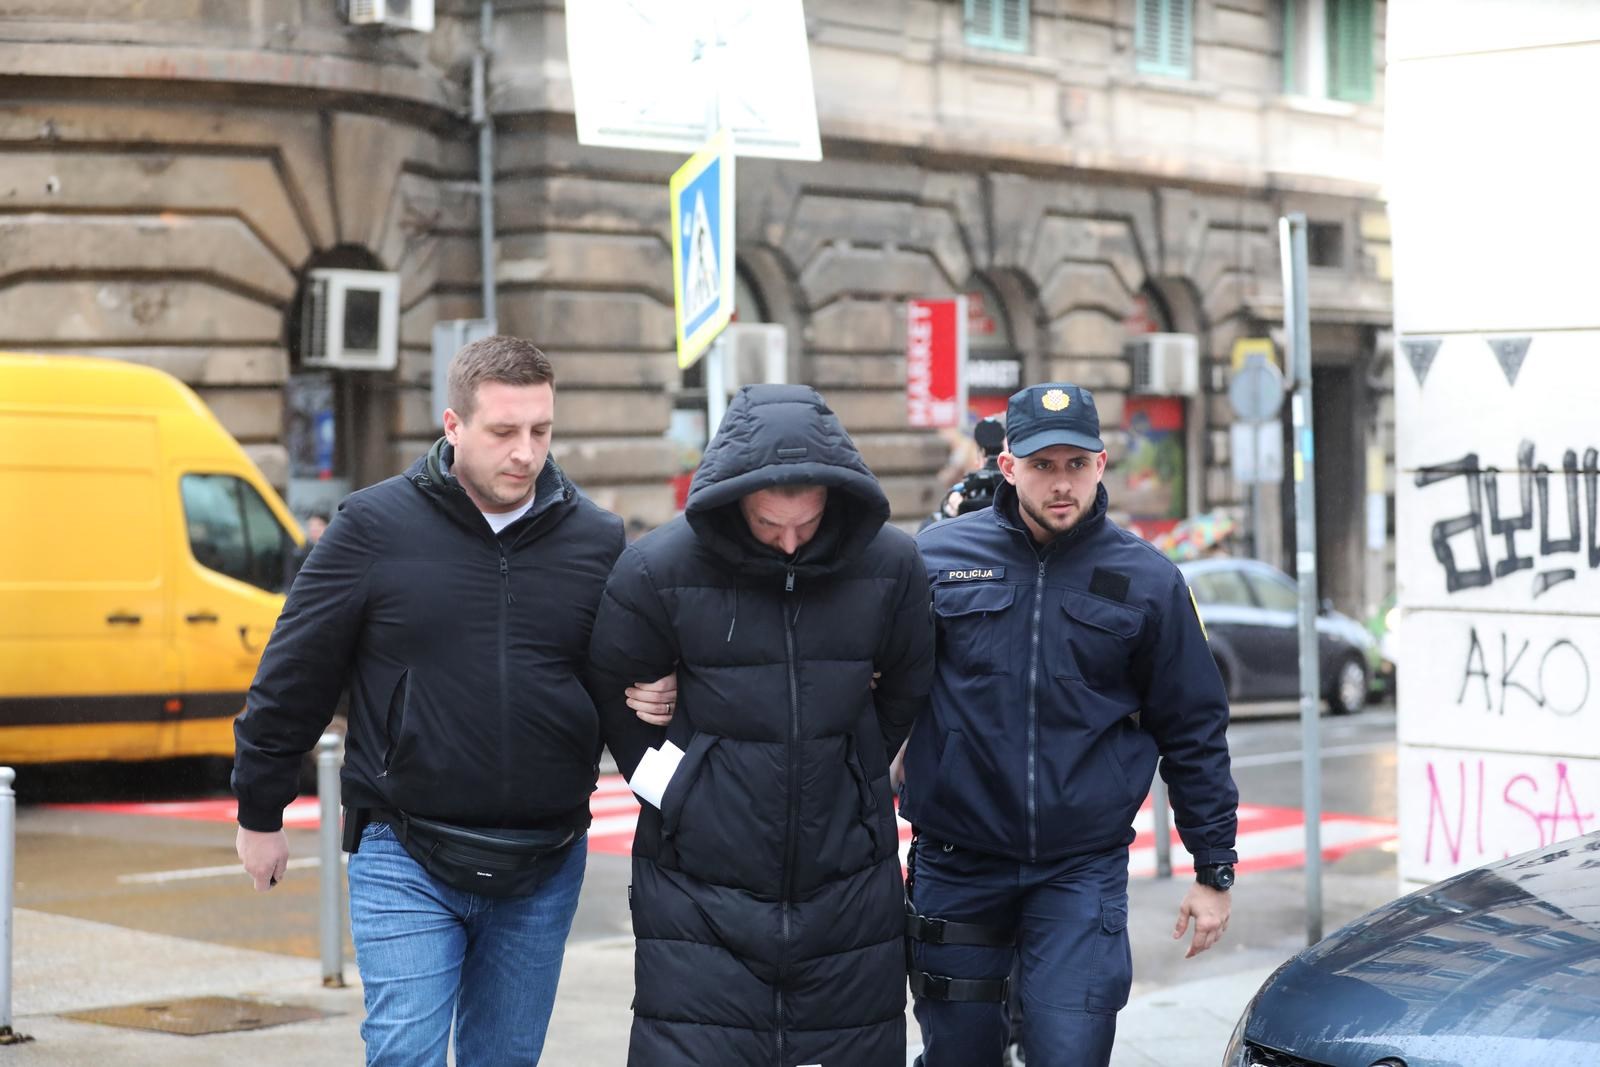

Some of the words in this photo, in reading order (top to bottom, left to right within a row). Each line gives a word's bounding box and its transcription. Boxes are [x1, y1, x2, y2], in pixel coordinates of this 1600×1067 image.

[907, 301, 931, 426] MARKET
[967, 360, 1020, 387] ARKET
[948, 568, 993, 579] POLICIJA
[1456, 626, 1591, 717] AKO
